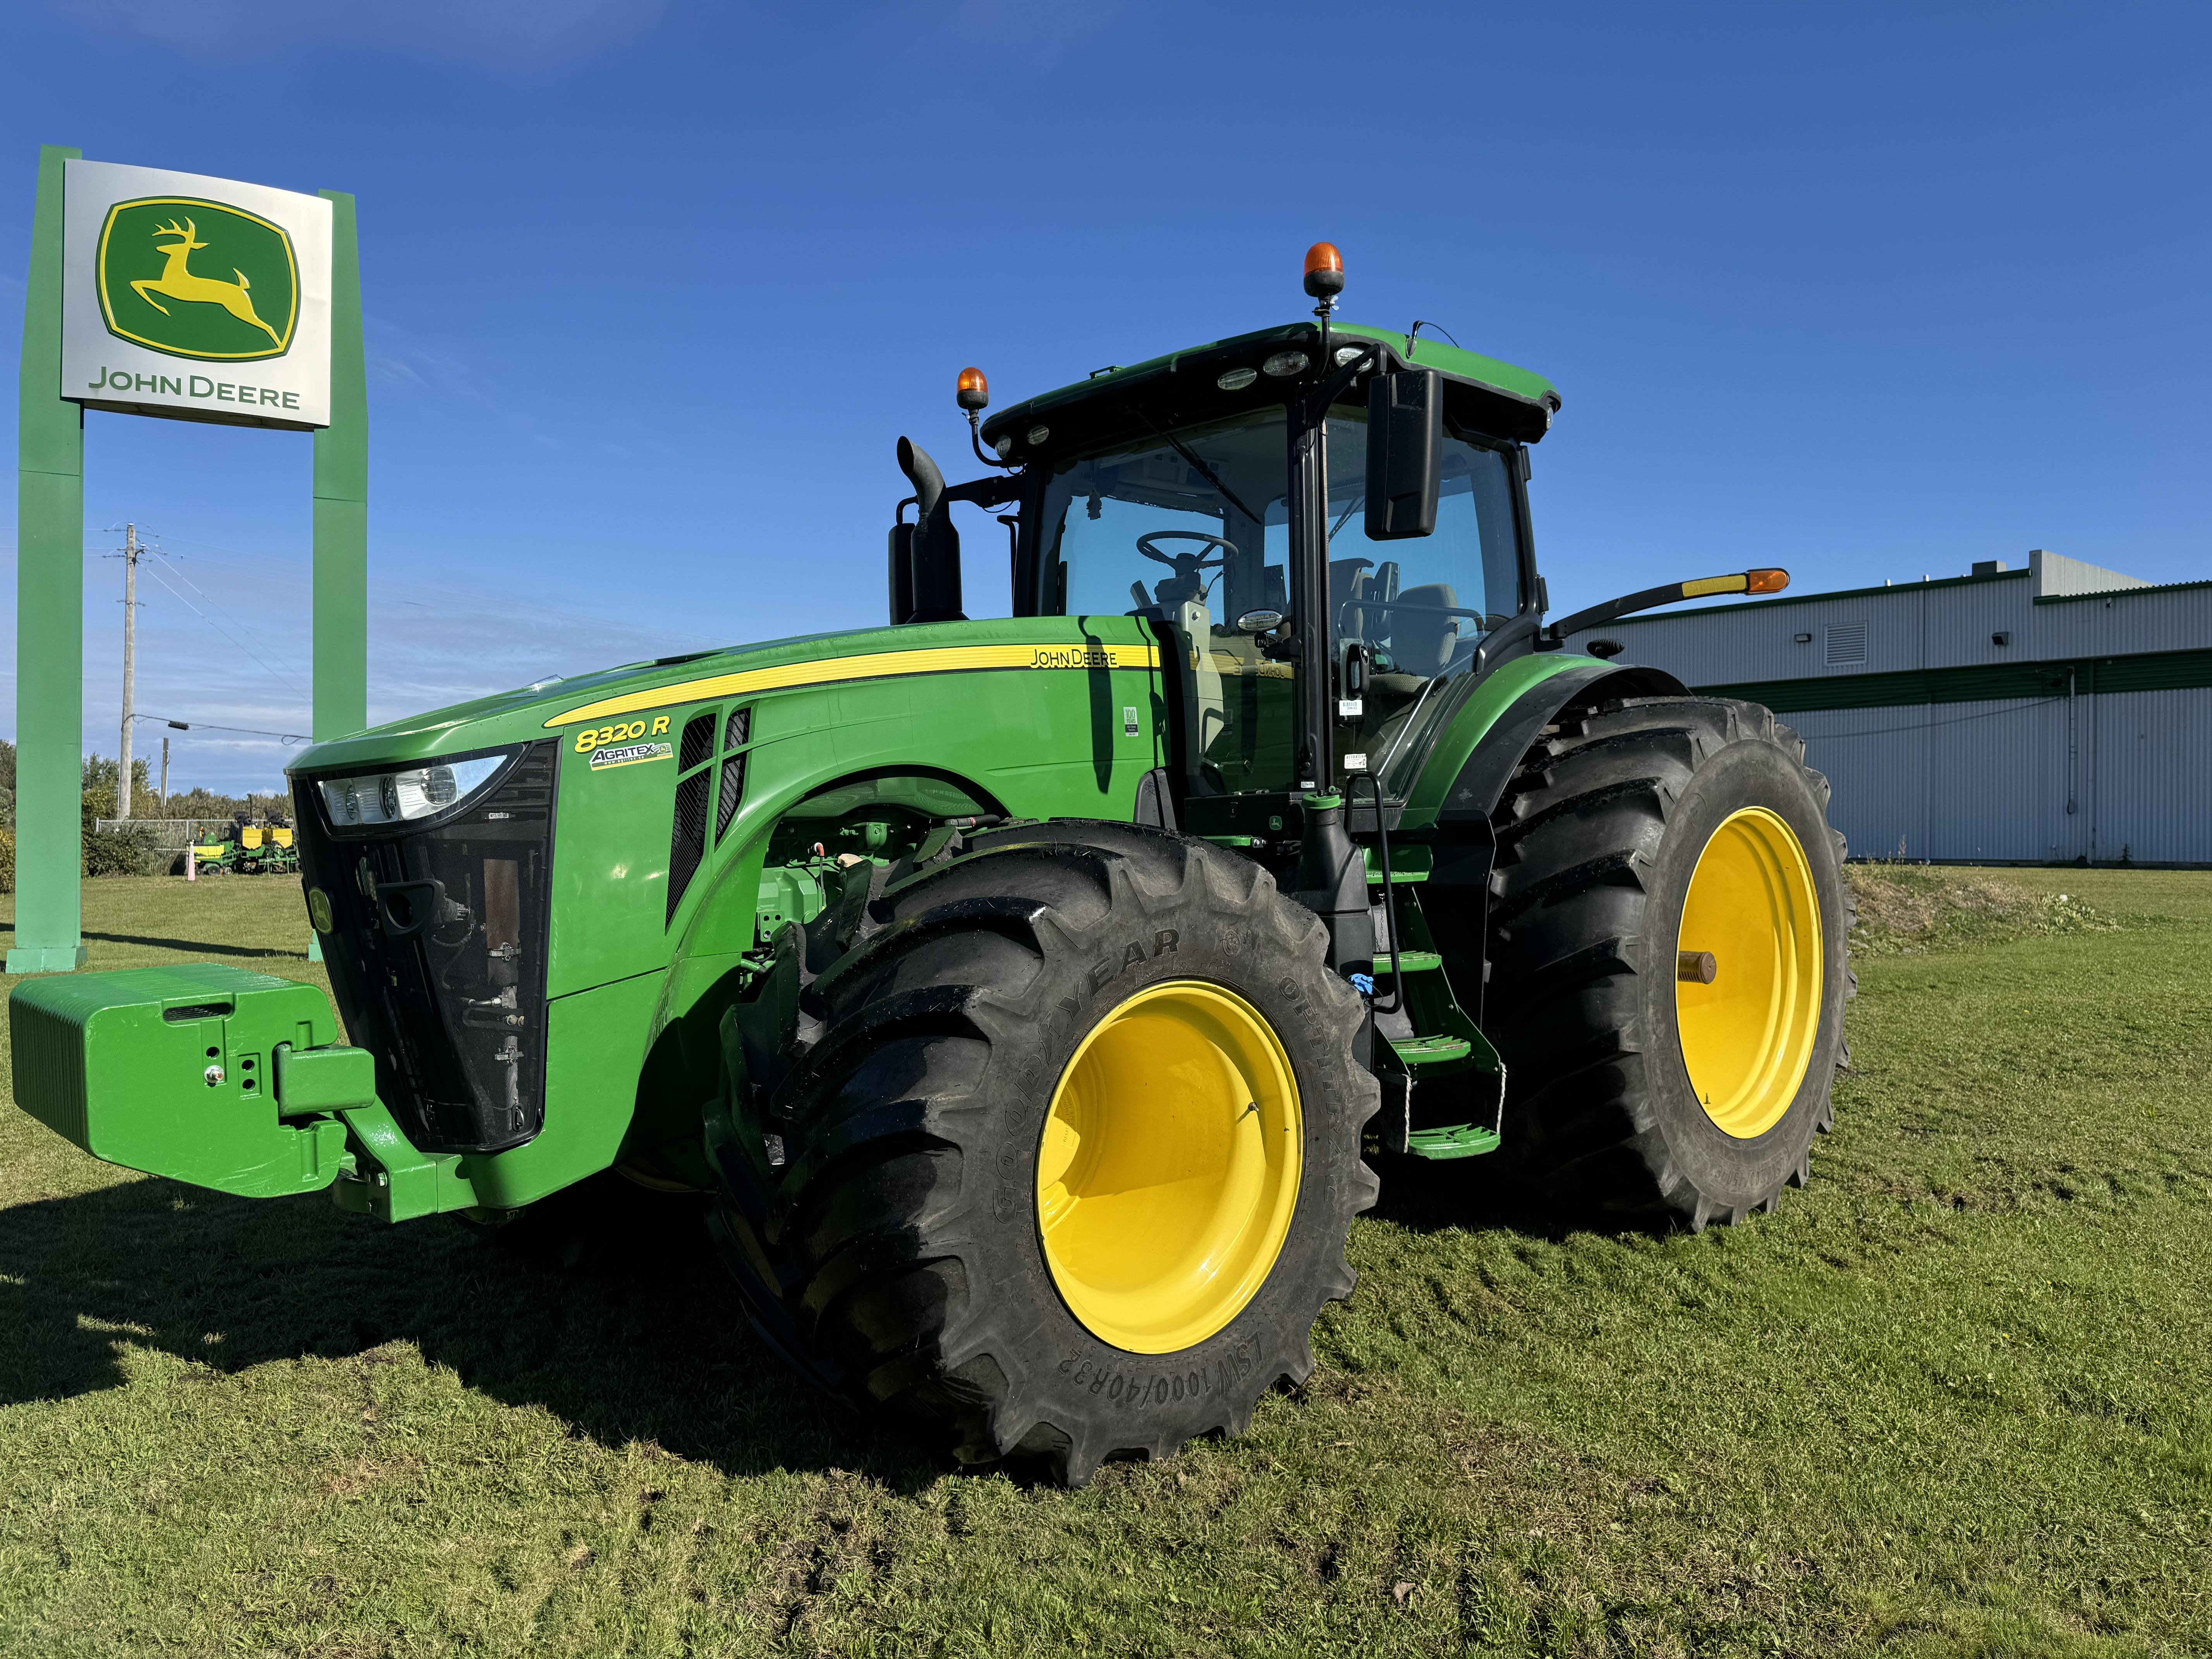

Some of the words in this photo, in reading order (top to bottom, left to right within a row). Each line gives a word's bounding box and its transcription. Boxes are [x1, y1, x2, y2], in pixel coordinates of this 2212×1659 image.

[88, 366, 181, 396] JOHN
[190, 375, 300, 410] DEERE
[1030, 649, 1070, 665] JOHN
[1071, 649, 1117, 665] DEERE
[574, 720, 646, 753] 8320
[651, 715, 670, 736] R
[591, 744, 654, 762] AGRITEX
[1057, 1348, 1211, 1410] 1000/40R32
[1217, 1331, 1263, 1397] LSW
